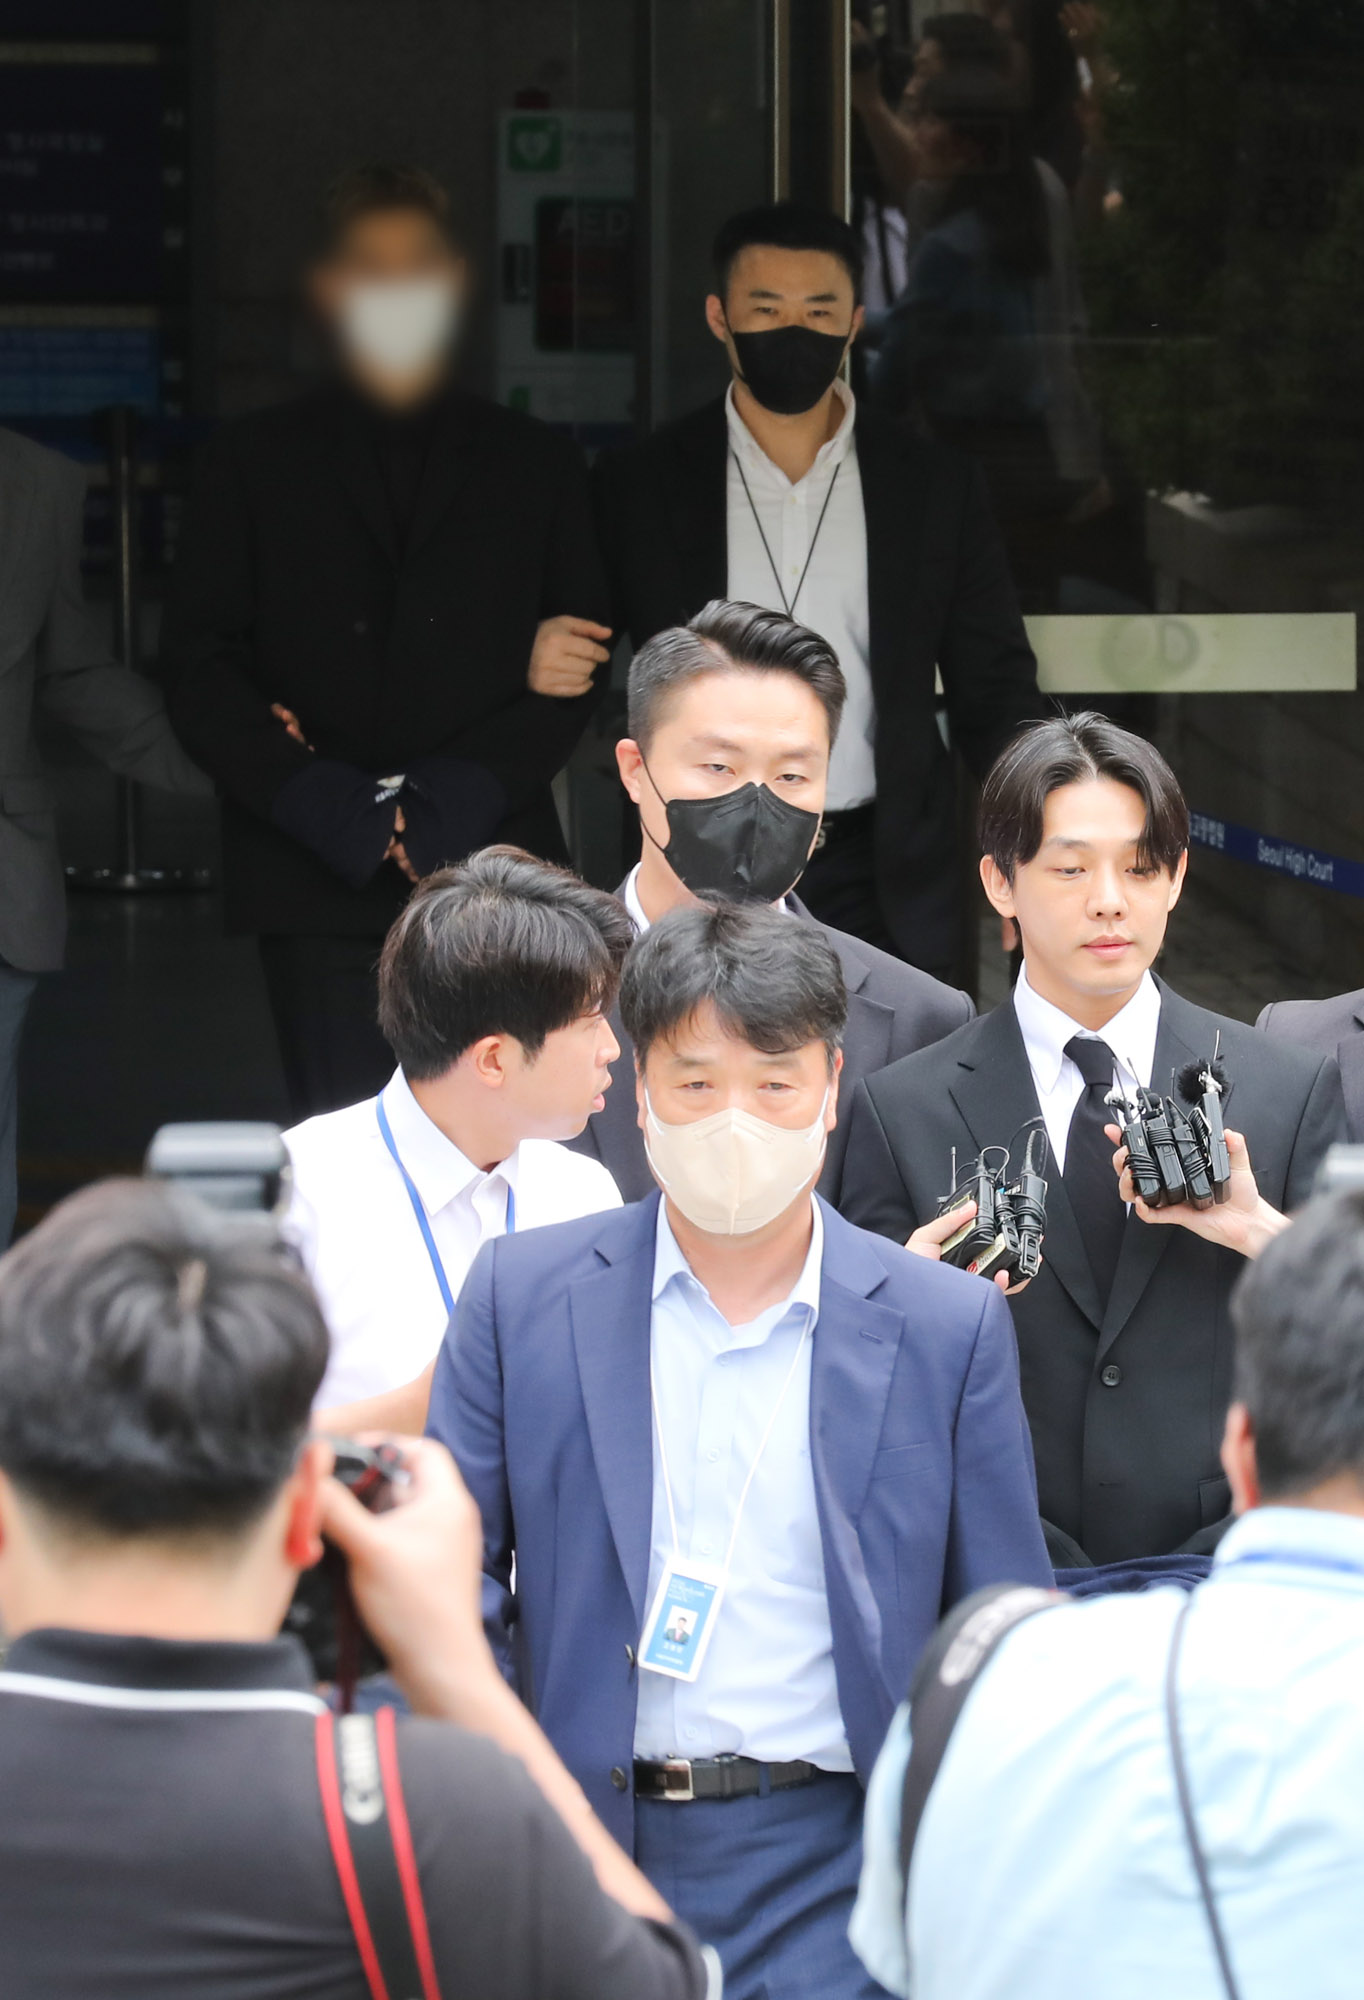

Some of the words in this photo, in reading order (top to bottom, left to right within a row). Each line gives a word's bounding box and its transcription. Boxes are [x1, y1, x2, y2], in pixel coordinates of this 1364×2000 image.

[556, 206, 631, 239] AED
[1188, 812, 1225, 849] 고등법원
[1257, 838, 1284, 867] Seoul
[1285, 846, 1306, 875] High
[1307, 853, 1333, 882] Court
